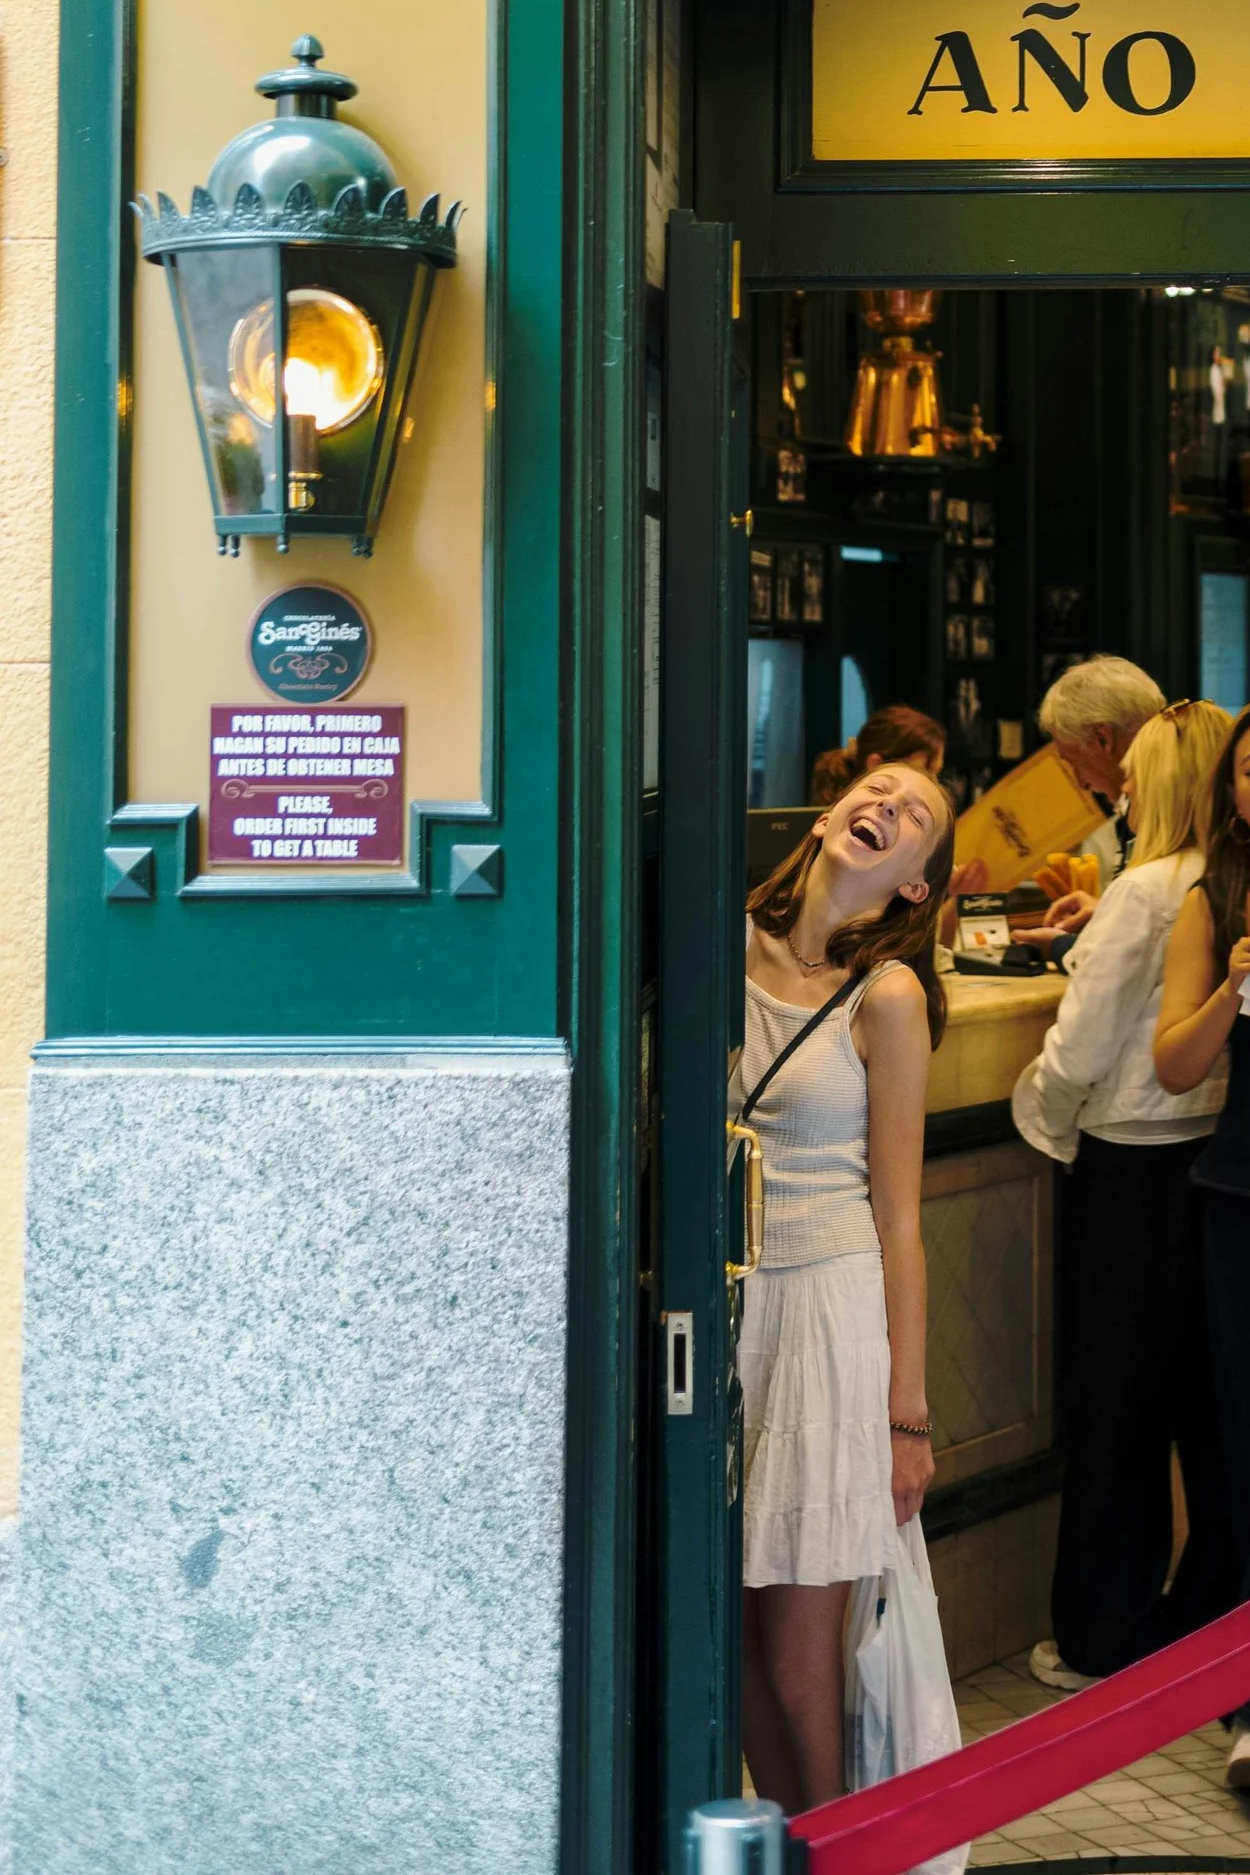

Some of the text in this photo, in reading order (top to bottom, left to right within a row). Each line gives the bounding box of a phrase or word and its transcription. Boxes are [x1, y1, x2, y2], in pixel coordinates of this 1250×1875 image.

[906, 1, 1196, 117] AÑO
[231, 715, 382, 733] POR FAVOR, PRIMERO
[212, 737, 400, 754] HAGAN SU PEDIDO EN CAJA
[217, 759, 395, 776] ANTES DE OBTENER MESA
[277, 796, 333, 815] PLEASE,
[233, 818, 377, 836] ORDER FIRST INSIDE
[251, 839, 358, 858] TO GET A TABLE
